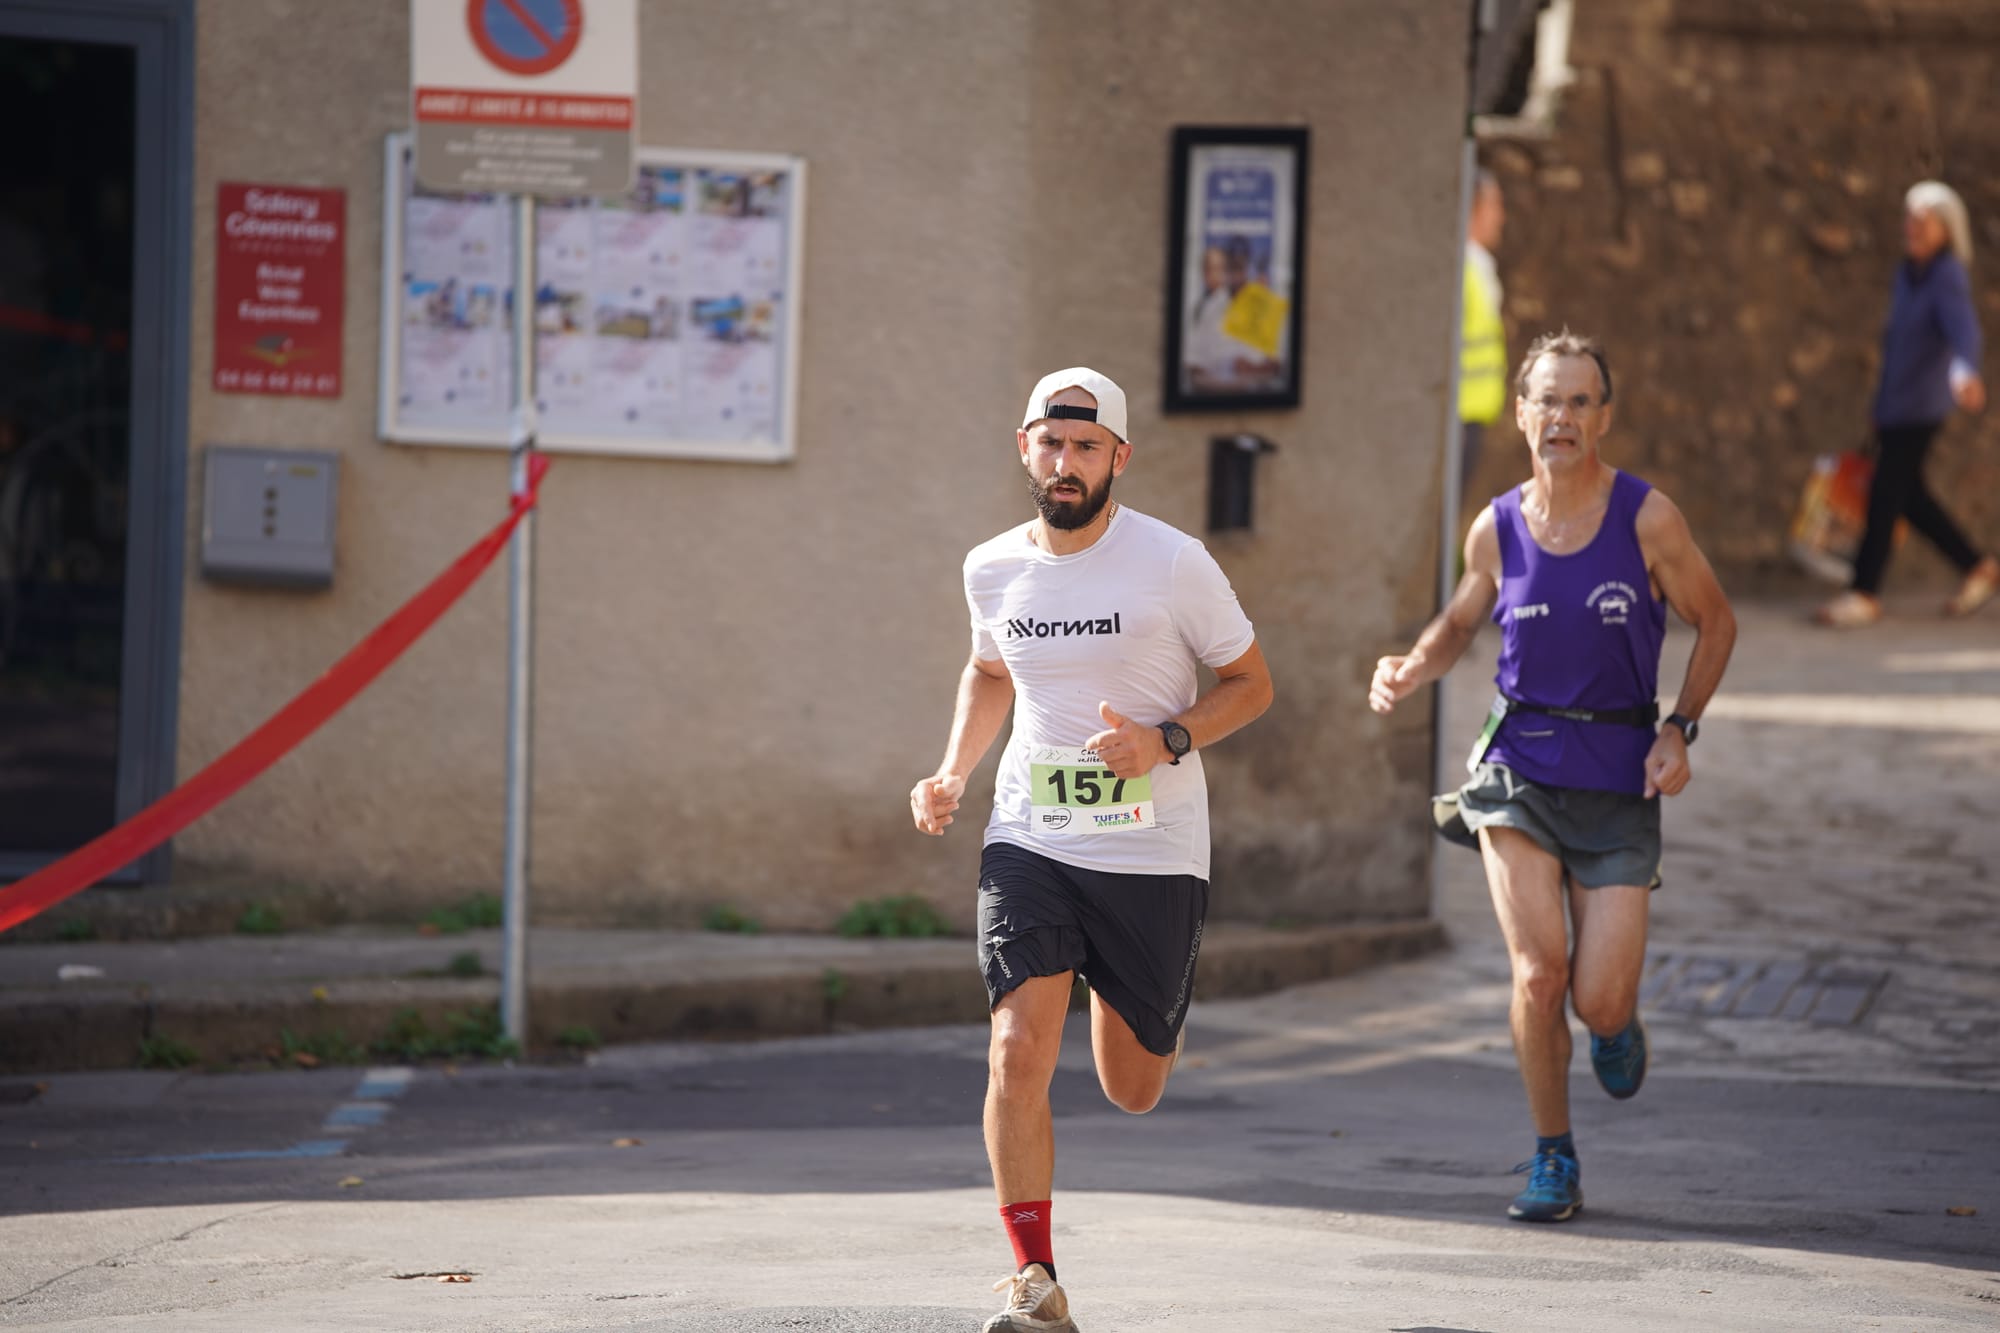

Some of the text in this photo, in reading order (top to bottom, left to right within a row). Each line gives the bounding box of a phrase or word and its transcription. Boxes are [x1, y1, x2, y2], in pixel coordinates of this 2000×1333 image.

[1048, 769, 1127, 805] 157
[1043, 815, 1068, 823] BFP
[1093, 812, 1131, 823] TUFF'S
